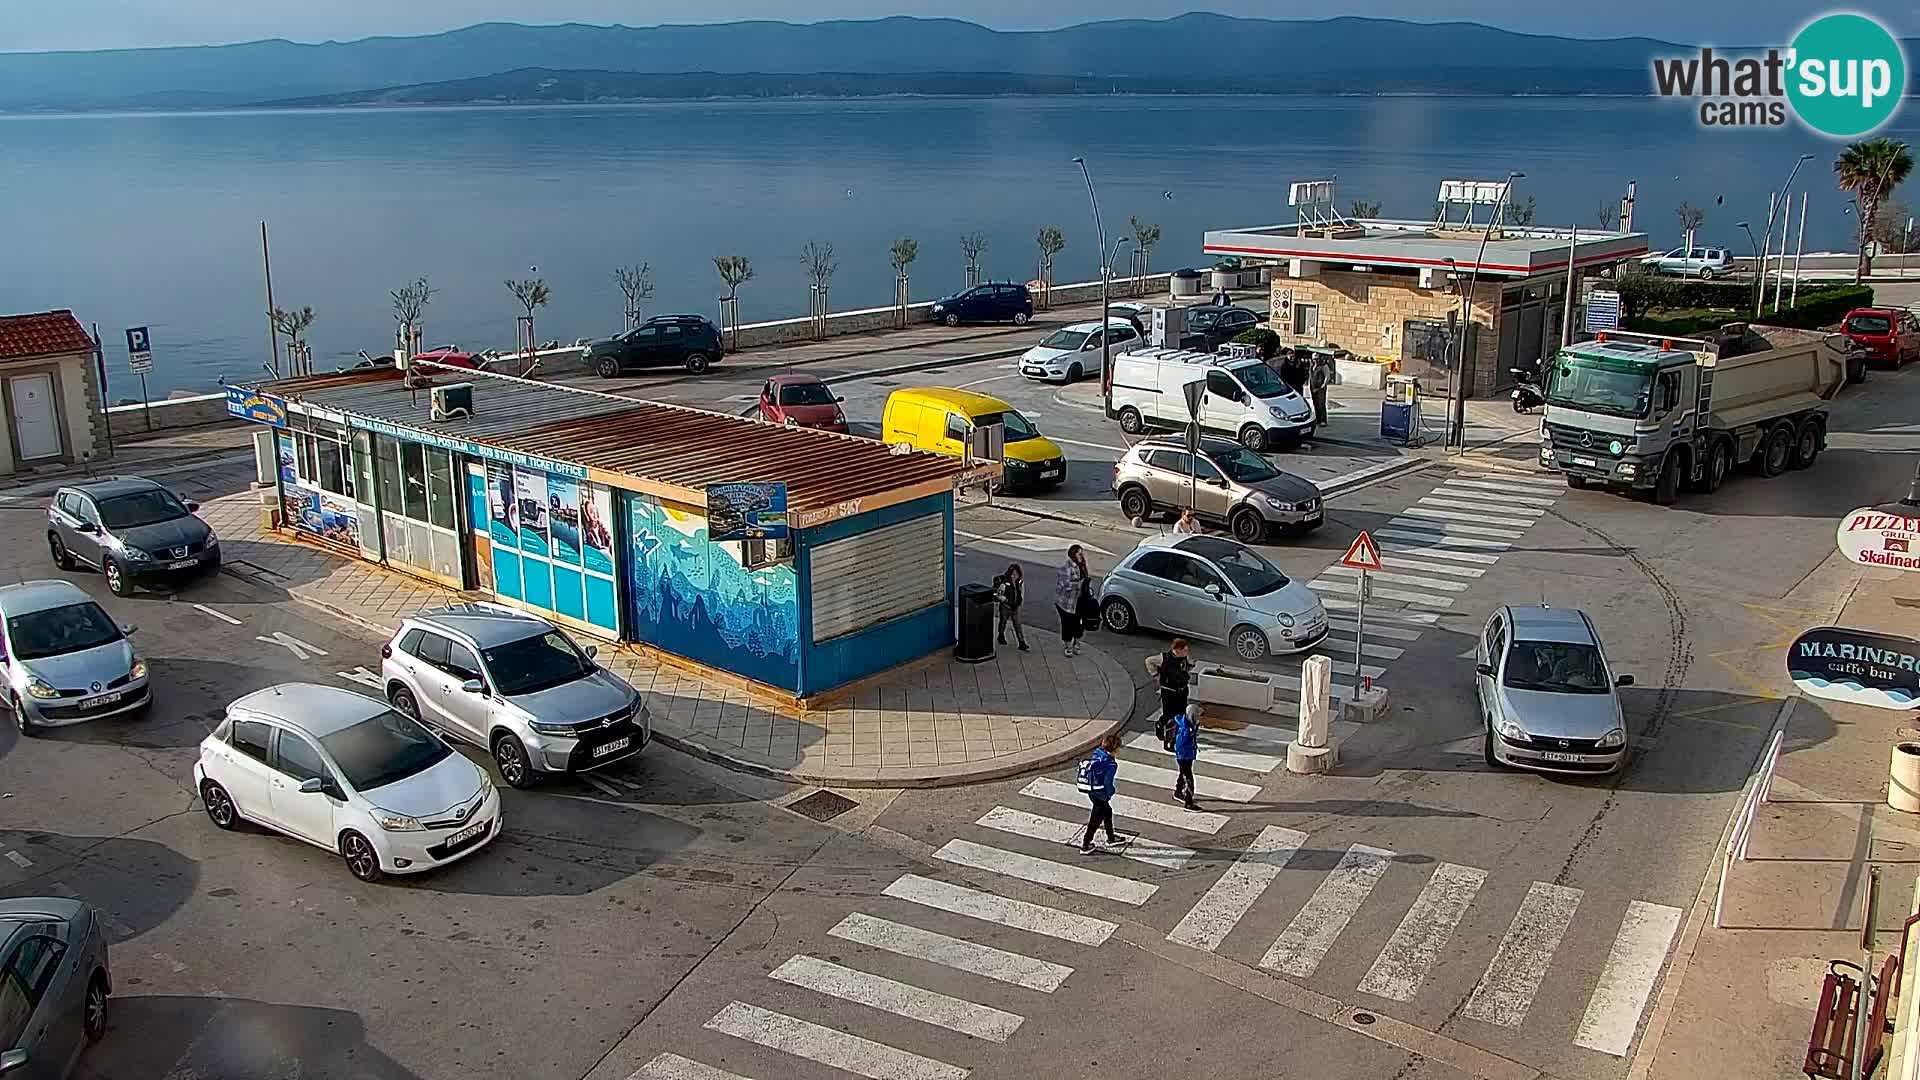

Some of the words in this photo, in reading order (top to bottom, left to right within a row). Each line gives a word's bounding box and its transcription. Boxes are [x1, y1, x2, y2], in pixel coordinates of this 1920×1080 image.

[132, 331, 144, 349] P
[438, 438, 469, 451] POSTAJA
[479, 445, 494, 457] BUS
[495, 449, 527, 465] STATION
[529, 457, 554, 472] TICKET
[556, 463, 583, 477] OFFICE
[1847, 515, 1920, 534] PIZZE
[1881, 530, 1917, 541] GRILL
[1828, 663, 1865, 675] caffe
[1870, 665, 1896, 680] bar
